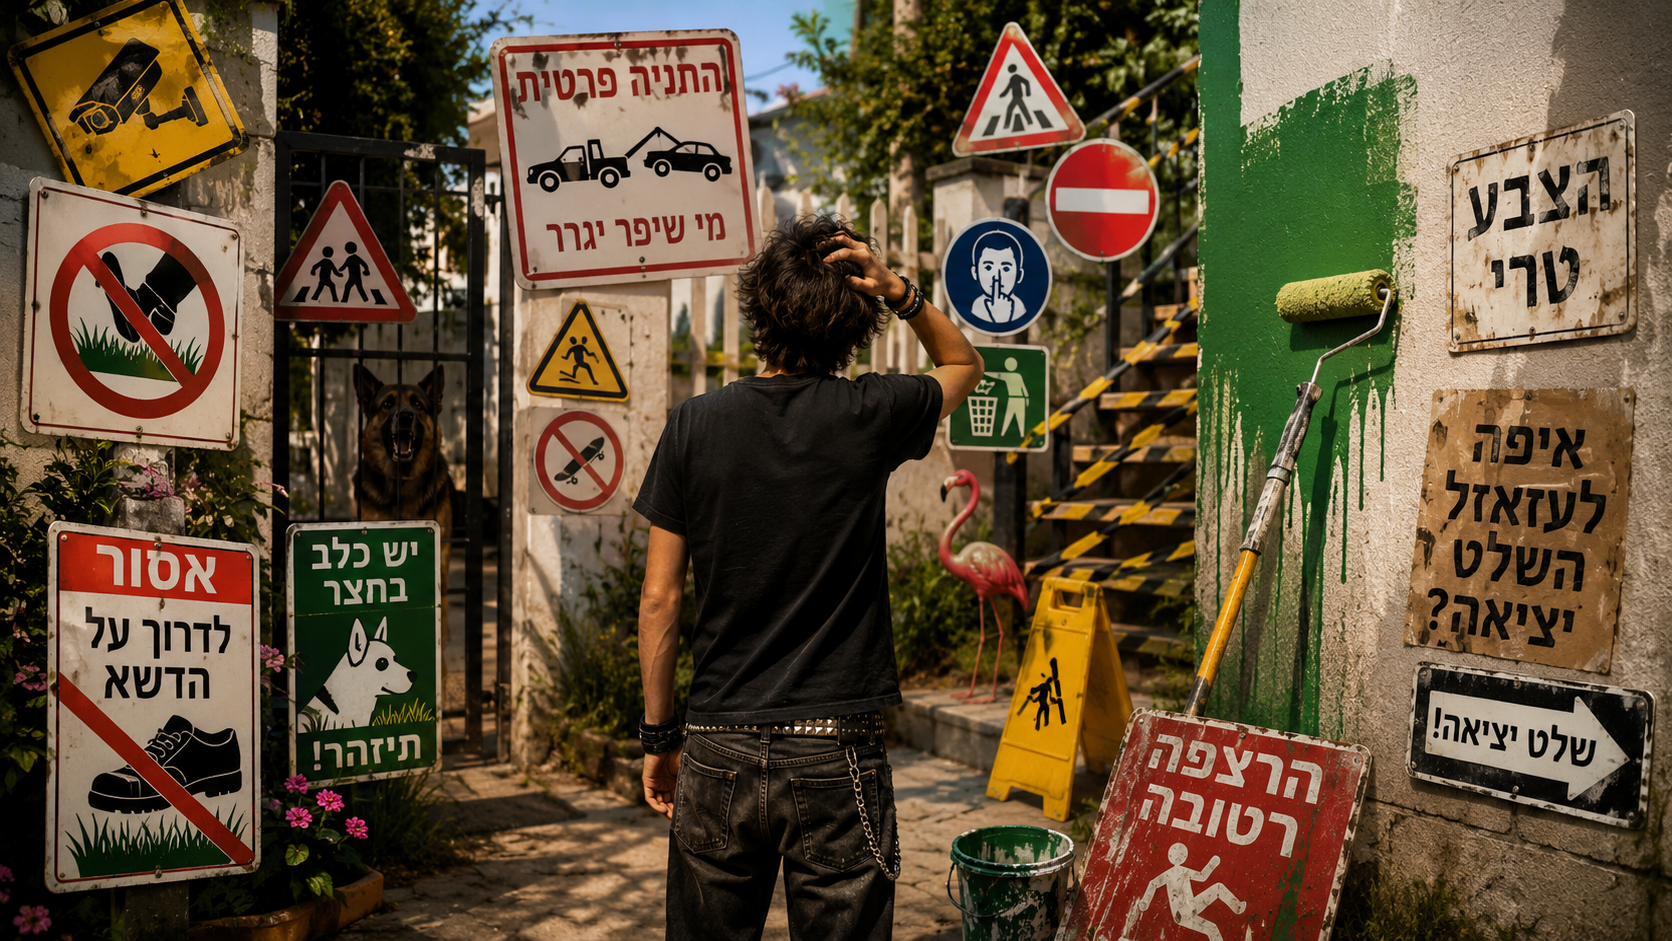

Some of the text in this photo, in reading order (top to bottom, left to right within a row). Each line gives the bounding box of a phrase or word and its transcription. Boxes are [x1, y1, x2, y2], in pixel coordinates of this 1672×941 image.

[516, 67, 617, 102] פרטית
[1467, 156, 1610, 241] הצבע
[546, 212, 726, 252] מי שיפר יגרר
[1491, 245, 1580, 308] טרי
[1472, 424, 1586, 470] איפה
[1445, 470, 1607, 534] לעזאזל
[96, 544, 217, 594] אסור
[311, 536, 418, 570] יש כלב
[1453, 531, 1585, 592] השלט
[85, 606, 230, 659] לדרוך על
[1427, 588, 1575, 648] יציאה?
[104, 665, 210, 699] הדשא
[313, 734, 421, 771] תיזהר!
[1432, 707, 1597, 767] שלט יציאה!
[1148, 734, 1323, 805] הרצפה
[1138, 783, 1298, 858] רטובה
